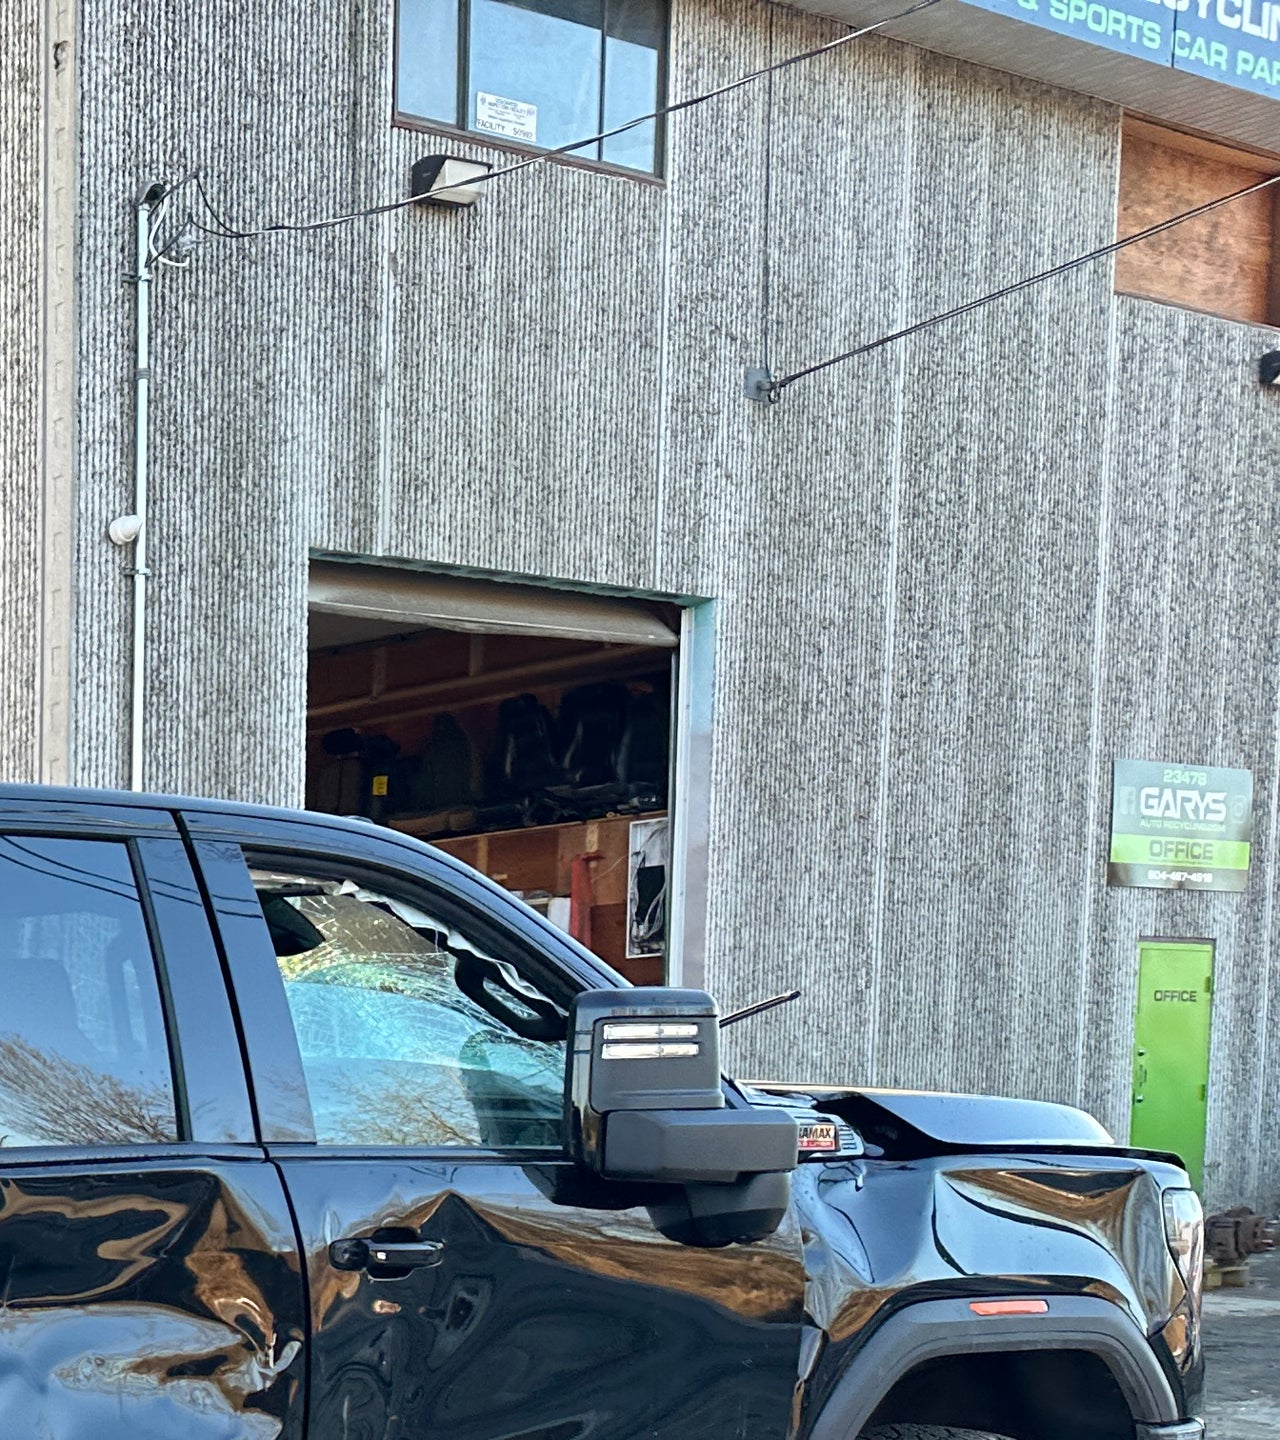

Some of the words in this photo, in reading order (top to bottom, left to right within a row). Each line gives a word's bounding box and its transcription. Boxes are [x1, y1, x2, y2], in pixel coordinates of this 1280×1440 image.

[1050, 0, 1161, 49] SPORTS
[1173, 29, 1228, 71] CAR
[1164, 769, 1207, 786] 23478
[1140, 787, 1228, 821] GARYS
[1140, 820, 1162, 829] AUTO
[1149, 839, 1214, 860] OFFICE
[1154, 990, 1197, 1002] OFFICE
